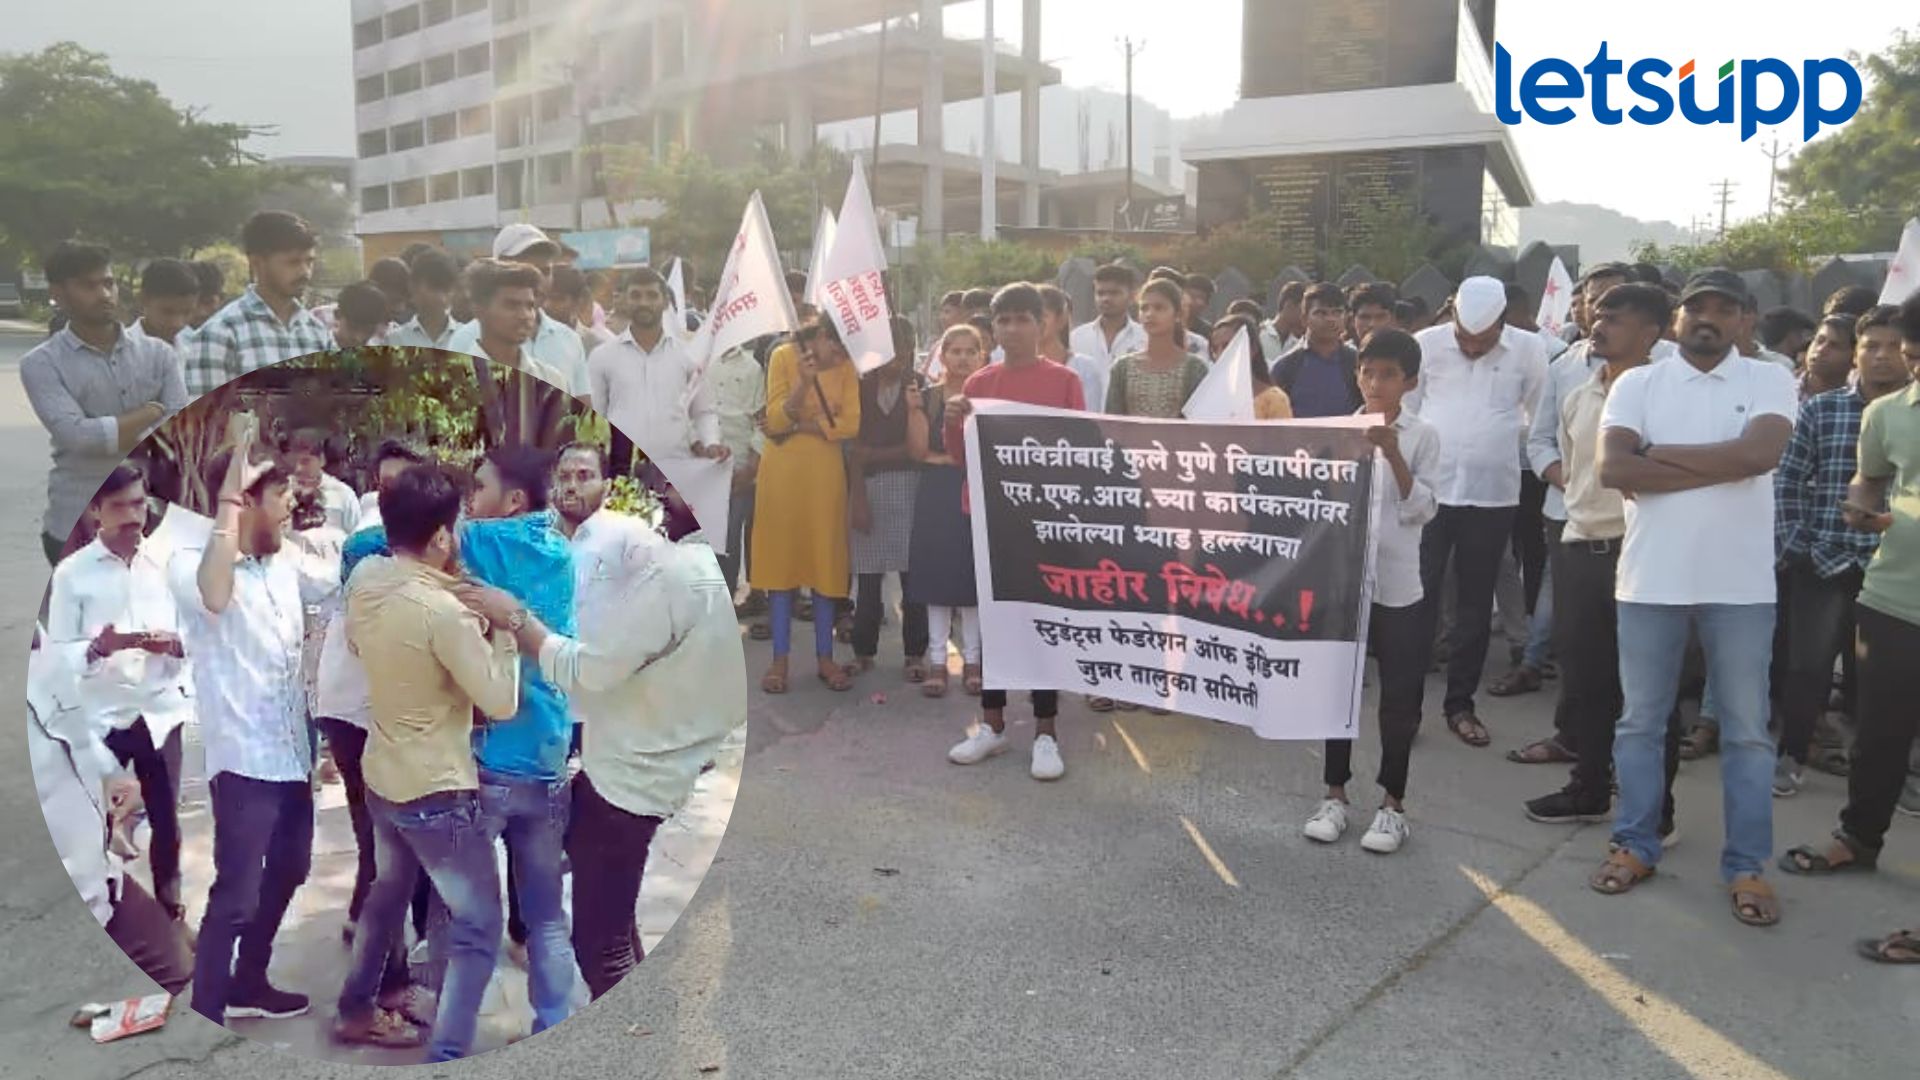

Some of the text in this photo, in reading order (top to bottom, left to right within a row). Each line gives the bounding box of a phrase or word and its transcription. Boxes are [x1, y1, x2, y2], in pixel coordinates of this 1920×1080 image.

[994, 436, 1359, 483] सावित्रीबाई फुले पुणे विद्यापीठात
[1032, 513, 1302, 560] झालेल्या भ्याड हल्ल्याचा
[1038, 558, 1149, 604] जाहीर
[1033, 617, 1300, 678] स्टुडंट्स फेडरेशन ऑफ इंडिया
[1076, 659, 1258, 708] जुन्नर तालुका समिती
